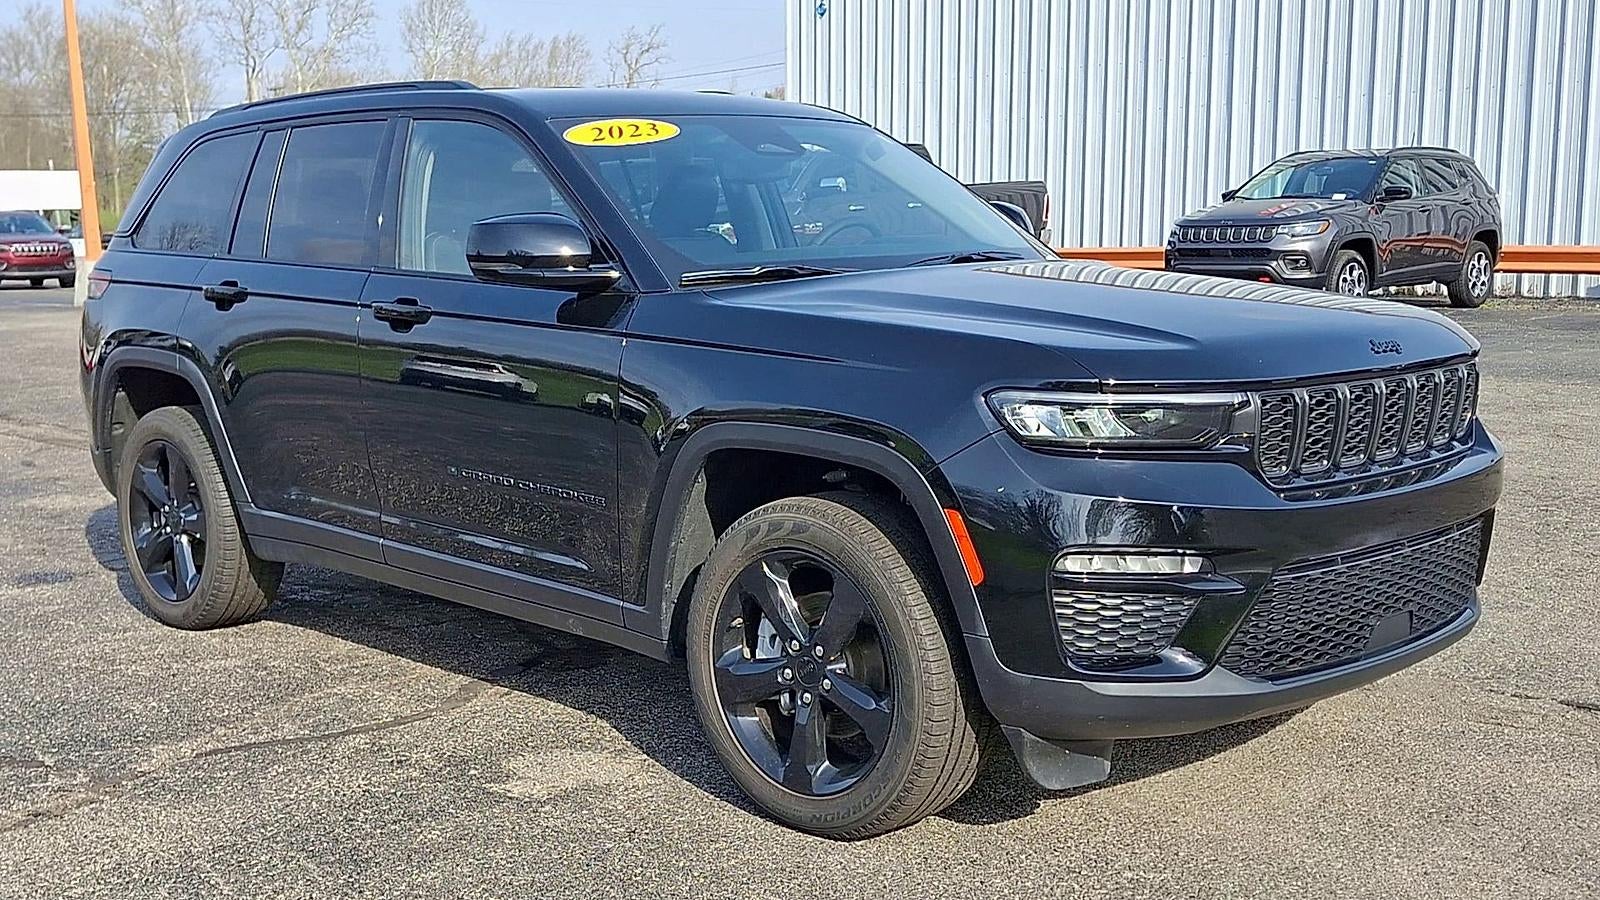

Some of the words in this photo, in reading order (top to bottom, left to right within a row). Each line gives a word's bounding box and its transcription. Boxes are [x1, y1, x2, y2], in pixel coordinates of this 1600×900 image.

[591, 123, 659, 142] 2023
[1369, 339, 1402, 355] Jeep
[461, 468, 514, 487] GRAND
[517, 479, 607, 507] CHEROKEE
